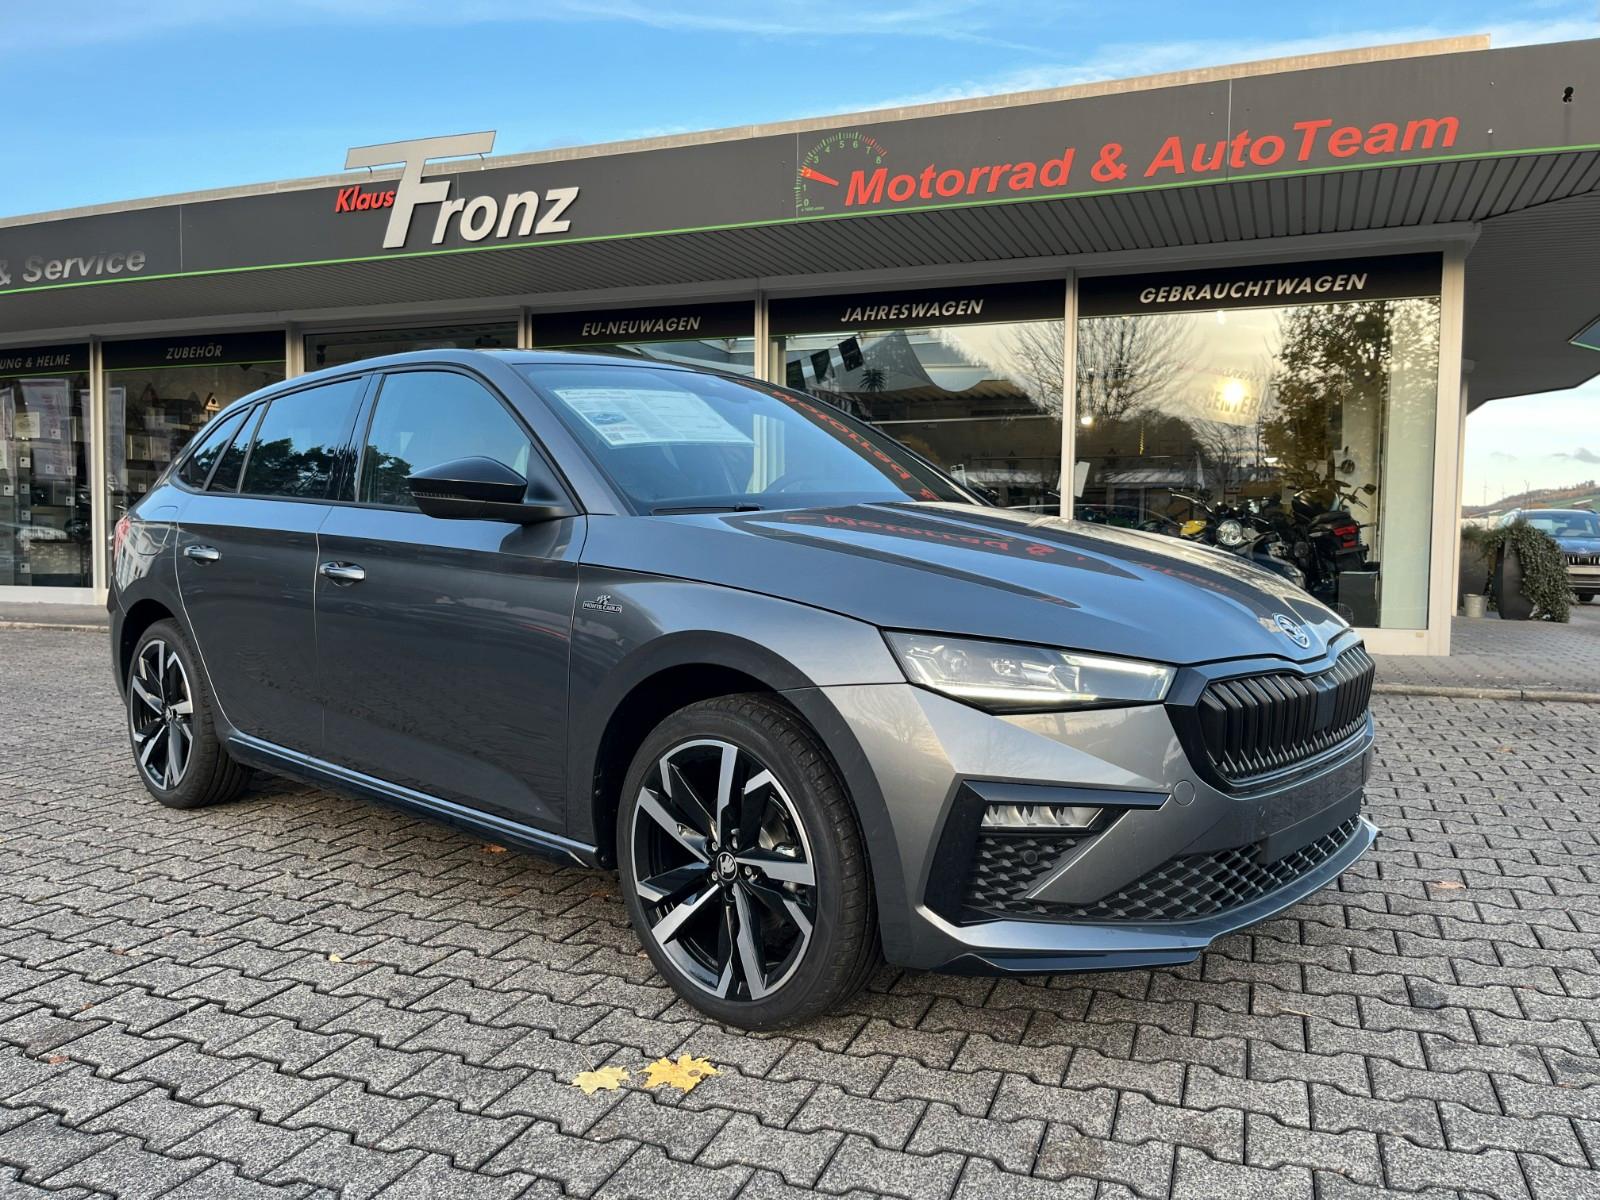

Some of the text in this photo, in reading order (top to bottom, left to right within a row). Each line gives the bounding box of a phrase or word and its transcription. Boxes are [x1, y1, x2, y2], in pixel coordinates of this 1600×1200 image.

[845, 148, 1076, 206] Motorrad
[1090, 143, 1127, 182] &
[335, 130, 580, 249] Klaus Fronz
[22, 250, 146, 283] Service
[1139, 273, 1368, 304] GEBRAUCHTWAGEN
[840, 299, 984, 323] JAHRESWAGEN
[581, 316, 701, 336] EU-NEUWAGEN
[25, 357, 33, 368] &
[36, 354, 71, 368] HELME
[165, 342, 223, 360] ZUBEHÖR
